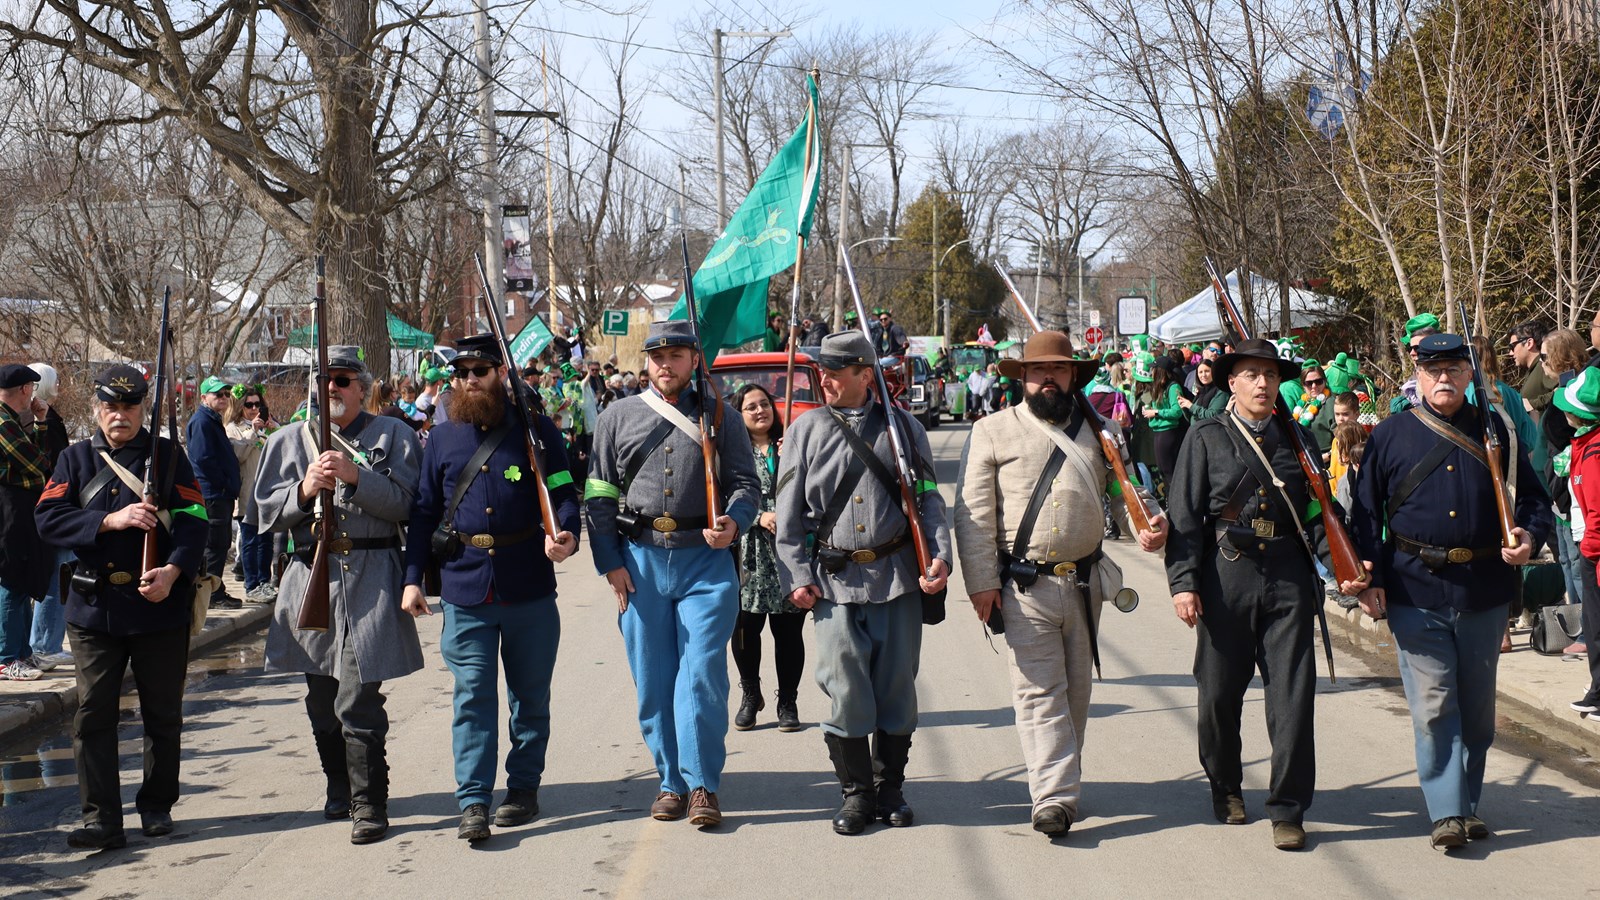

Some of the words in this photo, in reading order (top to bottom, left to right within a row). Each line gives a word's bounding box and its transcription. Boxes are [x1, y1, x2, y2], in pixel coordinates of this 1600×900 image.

[608, 312, 624, 330] P
[474, 536, 491, 546] US
[1452, 551, 1470, 561] US
